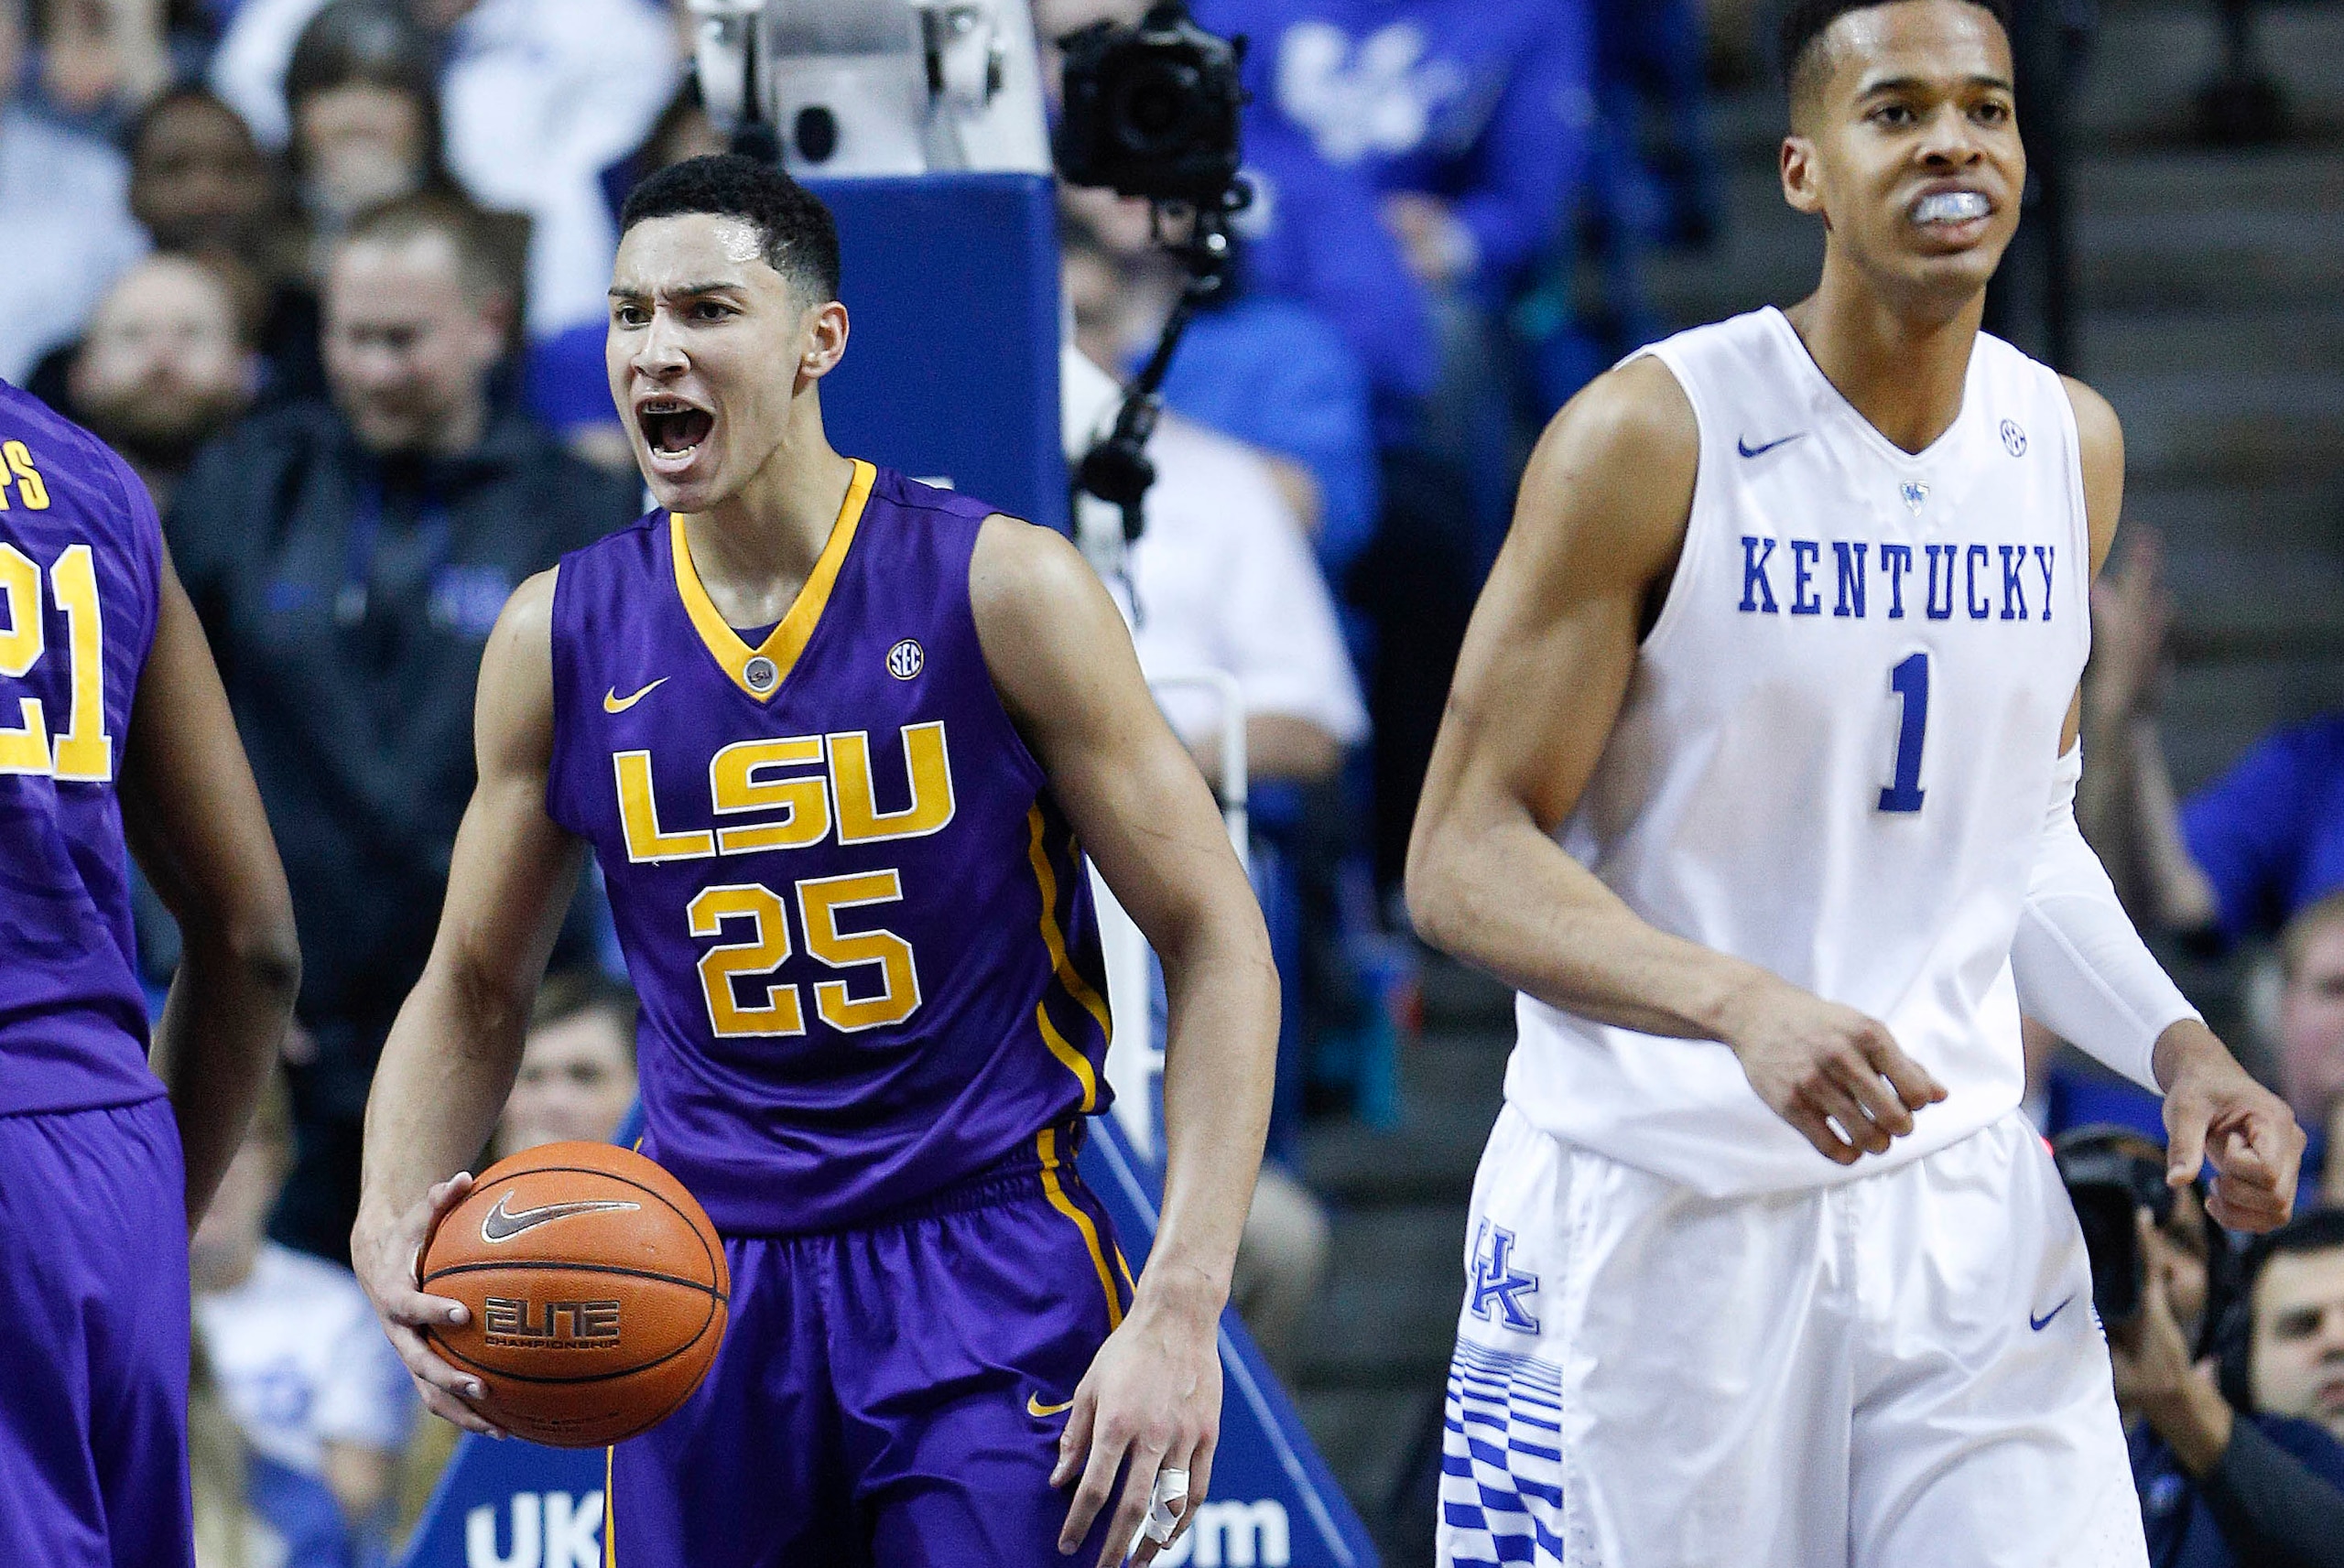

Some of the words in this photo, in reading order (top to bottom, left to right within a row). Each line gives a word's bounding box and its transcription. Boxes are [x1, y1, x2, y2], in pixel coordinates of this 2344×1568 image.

[1739, 536, 2055, 621] KENTUCKY
[0, 542, 113, 782] 21
[890, 643, 921, 676] SEC
[1877, 653, 1929, 812] 1
[613, 720, 956, 863] LSU
[686, 868, 922, 1037] 25
[484, 1296, 621, 1338] ELITE
[484, 1336, 621, 1349] CHAMPIONSHIP
